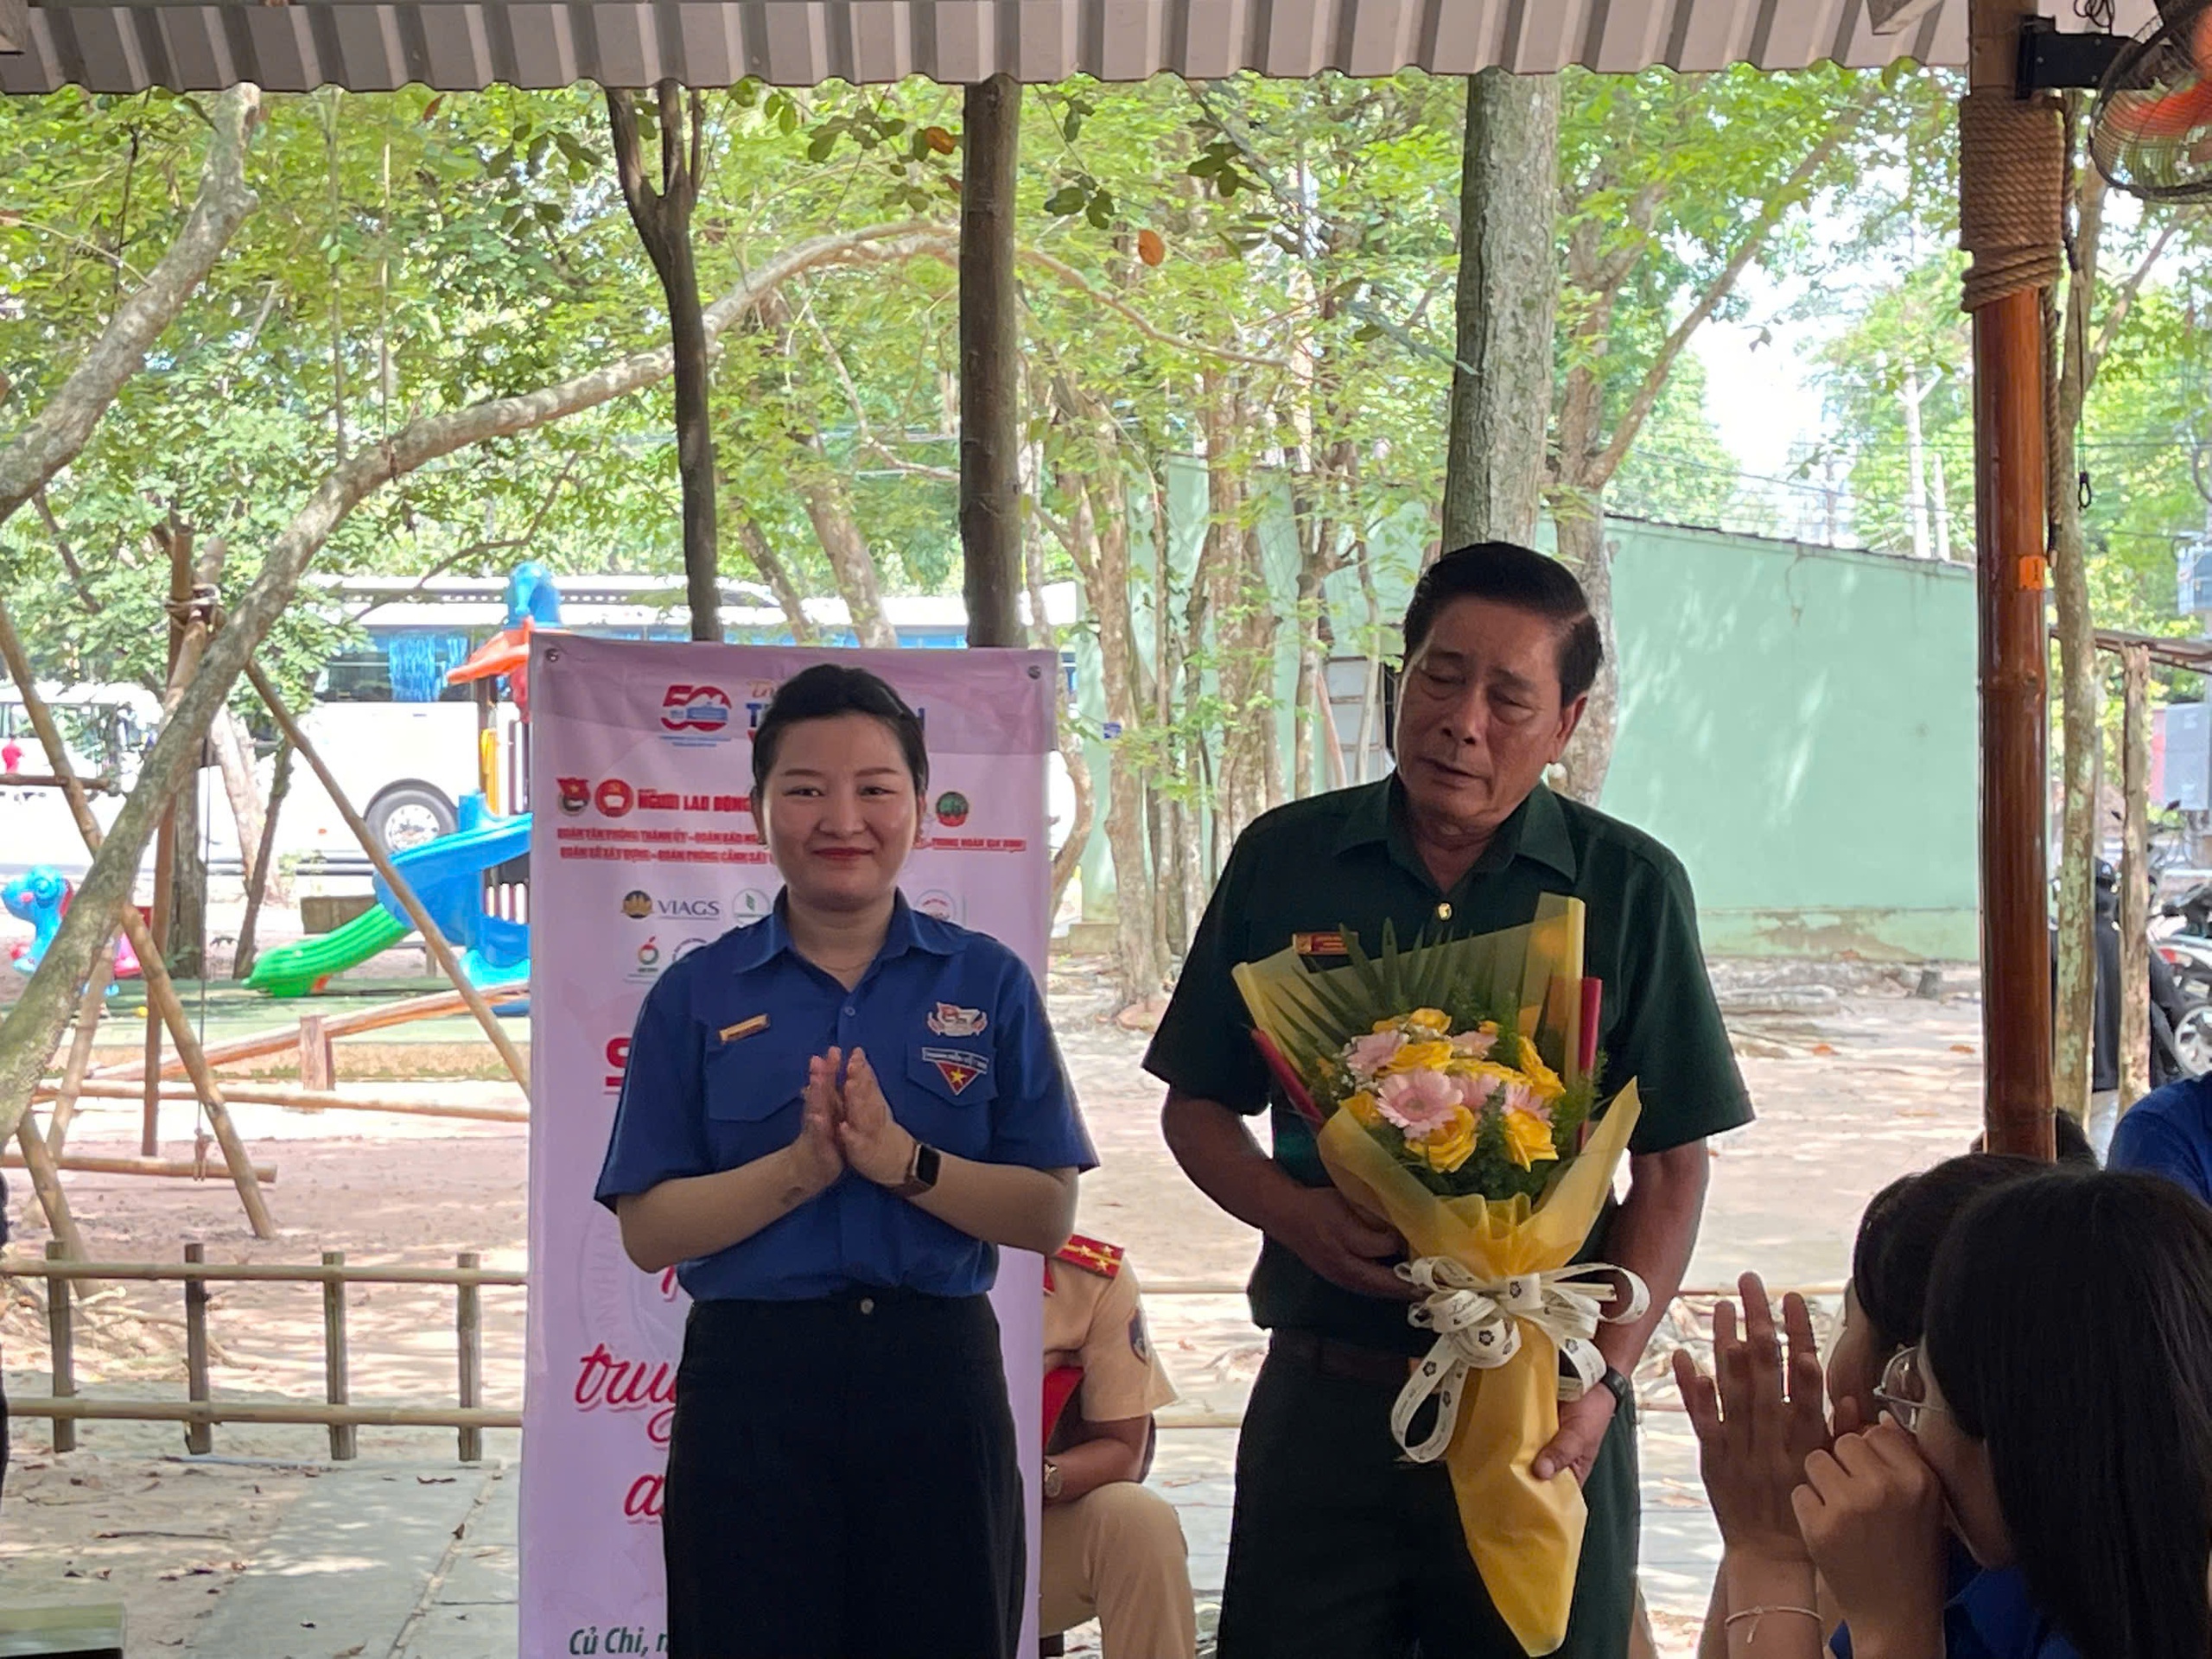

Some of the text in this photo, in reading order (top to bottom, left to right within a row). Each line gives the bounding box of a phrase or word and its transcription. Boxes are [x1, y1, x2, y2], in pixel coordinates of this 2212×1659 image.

[683, 795, 709, 810] LAO
[657, 899, 720, 916] VIAGS
[569, 1626, 598, 1655] Củ
[605, 1626, 648, 1657] Chi,
